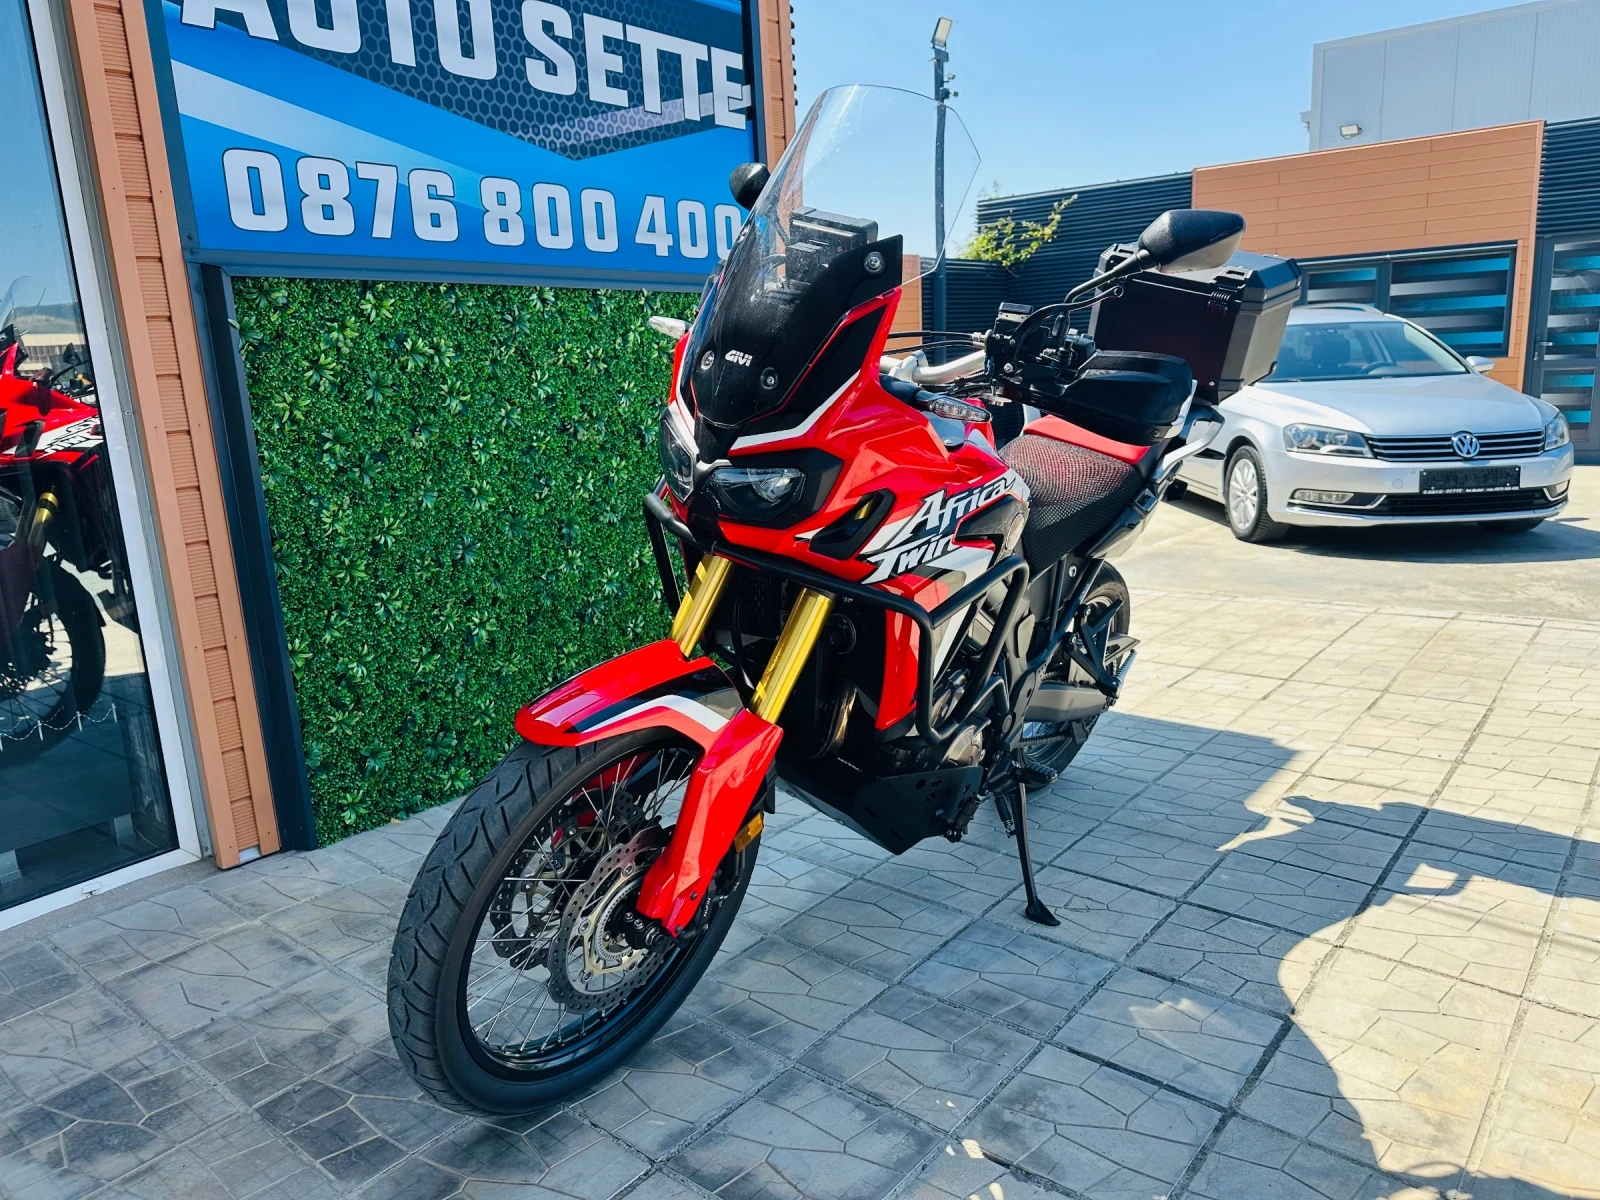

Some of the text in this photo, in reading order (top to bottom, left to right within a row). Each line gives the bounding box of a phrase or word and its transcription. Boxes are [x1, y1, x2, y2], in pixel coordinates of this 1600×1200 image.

[522, 0, 747, 130] SETTE
[222, 148, 742, 260] 0876 800 400
[724, 349, 753, 367] GIVI
[884, 475, 1017, 552] Africa
